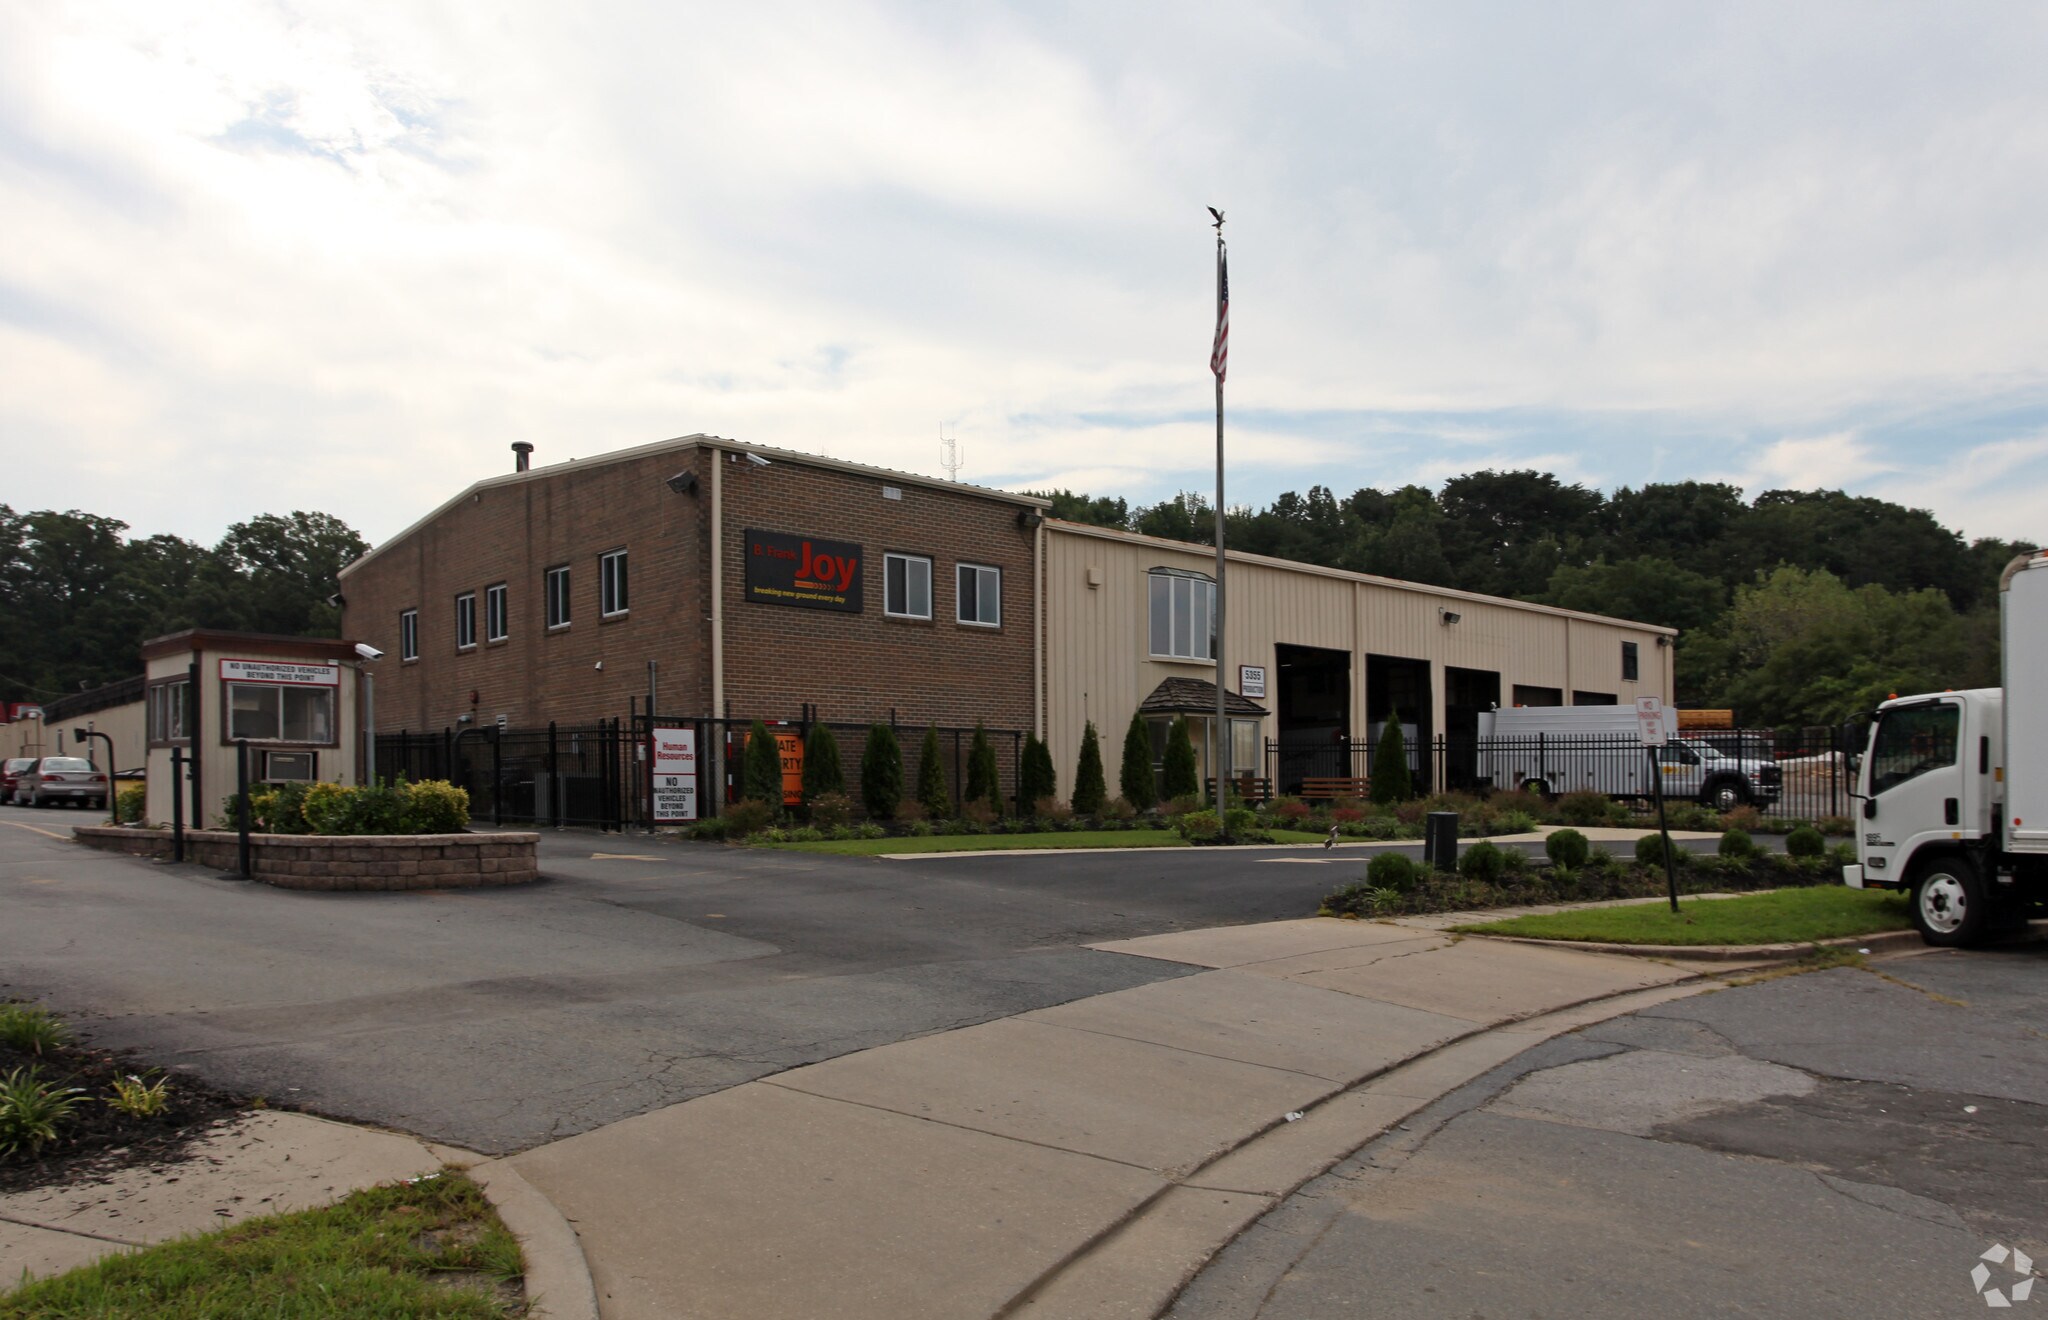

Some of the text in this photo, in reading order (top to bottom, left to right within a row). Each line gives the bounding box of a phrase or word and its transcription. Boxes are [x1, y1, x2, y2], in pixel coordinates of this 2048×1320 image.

[753, 541, 857, 593] B. Frank Joy
[753, 586, 846, 604] breaking new ground every day
[242, 663, 296, 673] UNAUTHORIZED
[298, 666, 331, 675] VEHICLES
[246, 671, 274, 679] BEYOND
[276, 672, 292, 680] THIS
[1245, 669, 1261, 681] 5355
[662, 742, 688, 751] Human
[657, 751, 694, 761] Resources
[665, 776, 678, 787] NO
